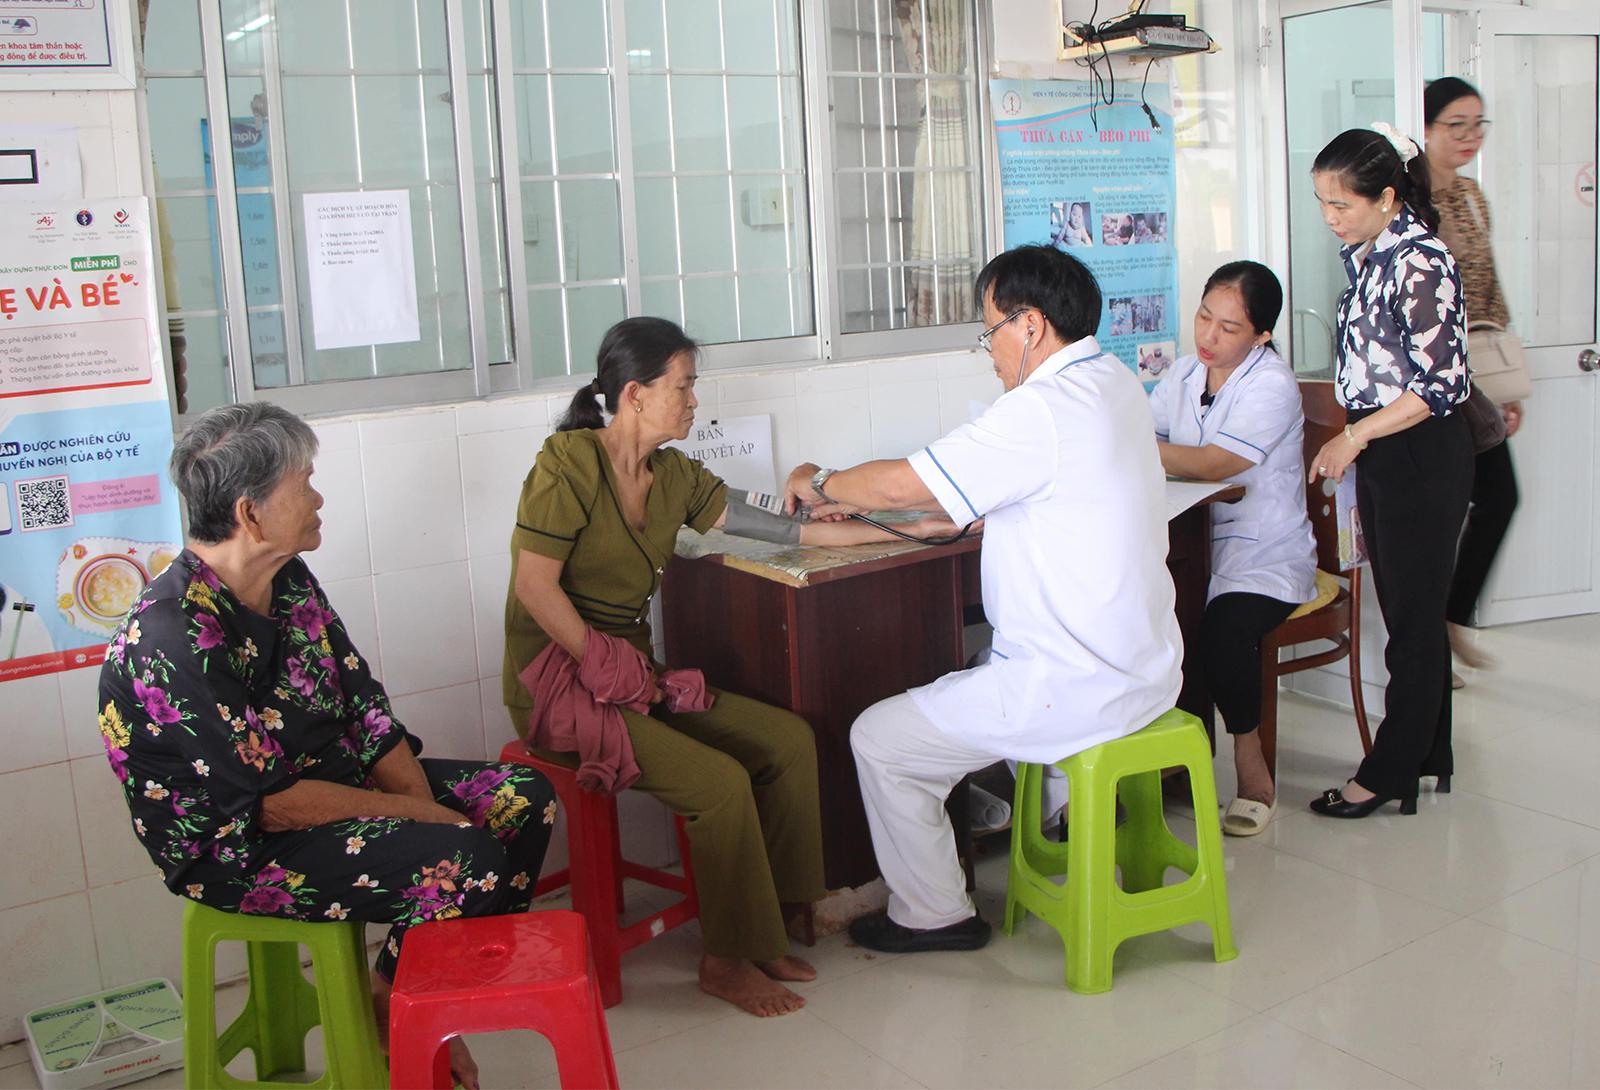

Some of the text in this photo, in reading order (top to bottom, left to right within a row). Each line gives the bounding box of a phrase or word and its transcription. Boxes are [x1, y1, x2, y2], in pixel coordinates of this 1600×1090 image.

[65, 42, 83, 50] hoặc
[39, 52, 57, 60] được
[74, 256, 98, 269] MIỄN
[101, 255, 117, 267] PHÍ
[25, 277, 72, 311] VÀ
[81, 274, 120, 307] BÉ
[23, 440, 56, 453] ĐƯỢC
[60, 434, 104, 448] NGHIÊN
[107, 431, 131, 443] CỨU
[740, 440, 755, 456] ÁP
[38, 455, 67, 466] NGHỊ
[70, 450, 94, 463] CỦA
[97, 447, 113, 461] BỘ
[116, 449, 123, 458] Y
[126, 444, 140, 457] TẾ
